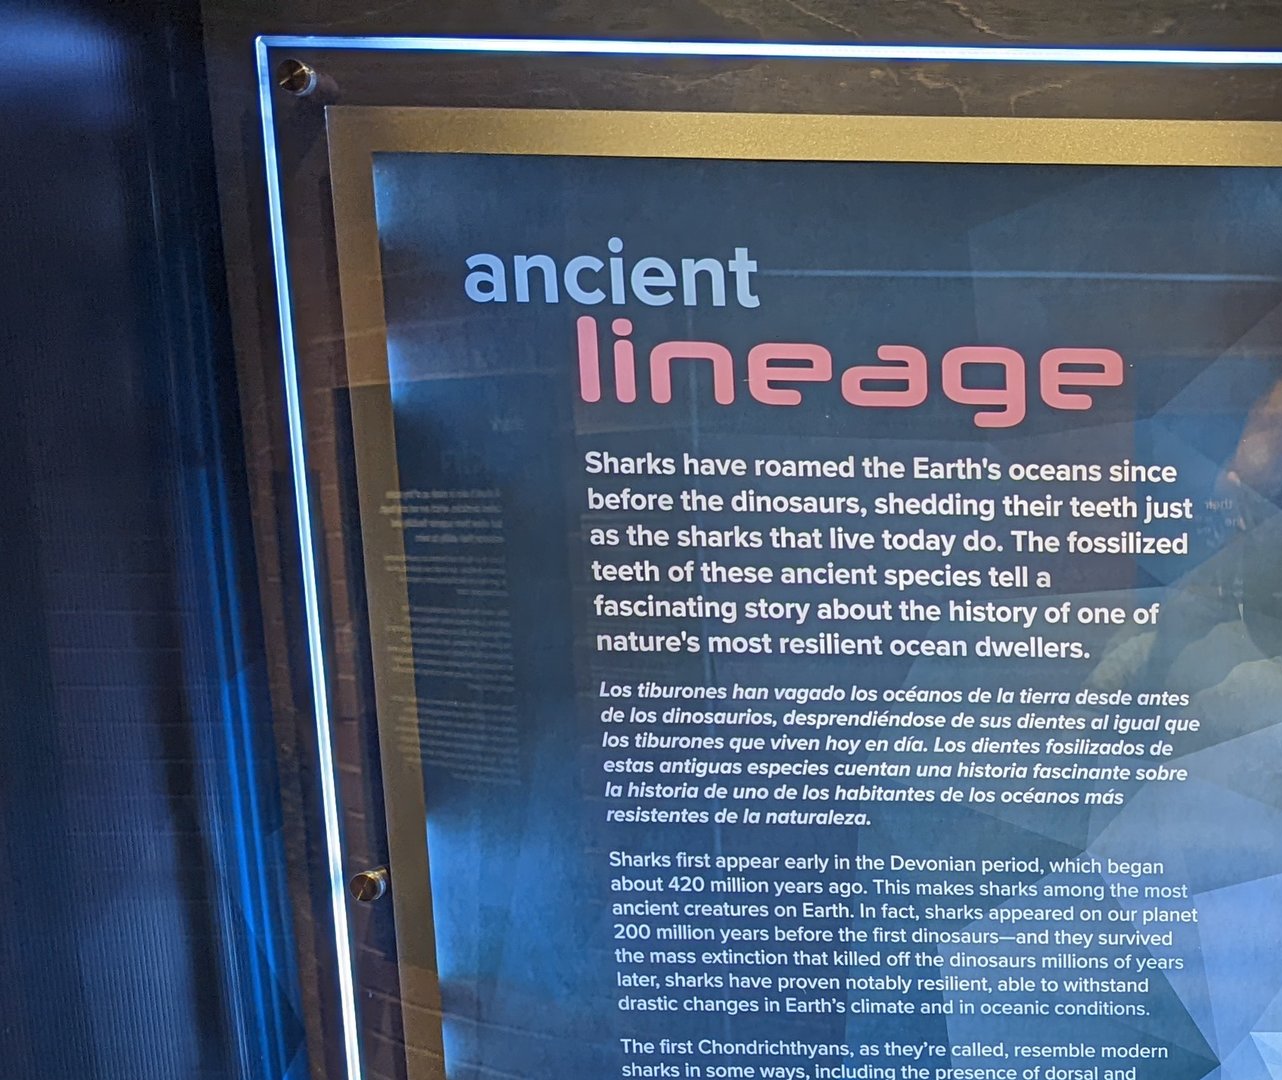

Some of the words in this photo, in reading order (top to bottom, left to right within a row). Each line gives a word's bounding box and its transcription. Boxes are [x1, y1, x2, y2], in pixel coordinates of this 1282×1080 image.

[464, 237, 760, 307] ancient
[576, 316, 1123, 427] lineage
[585, 450, 675, 475] Sharks
[683, 452, 747, 476] have
[754, 455, 854, 478] roamed
[861, 456, 905, 478] the
[913, 456, 1001, 480] Earth's
[1008, 463, 1102, 481] oceans
[1109, 459, 1177, 482] since
[587, 487, 673, 510] before
[680, 489, 724, 511] the
[730, 489, 867, 517] dinosaurs,
[874, 492, 994, 521] shedding
[1002, 494, 1063, 516] their
[1069, 495, 1137, 517] teeth
[1143, 495, 1193, 523] just
[590, 528, 619, 545] as
[625, 524, 669, 546] the
[677, 525, 762, 547] sharks
[769, 526, 823, 549] that
[829, 526, 875, 549] live
[881, 528, 956, 556] today
[963, 529, 1003, 551] do.
[1010, 530, 1060, 552] The
[1066, 530, 1187, 554] fossilized
[591, 560, 659, 581] teeth
[667, 560, 694, 582] of
[700, 560, 773, 583] these
[780, 561, 877, 585] ancient
[884, 563, 981, 590] species
[987, 565, 1028, 587] tell
[1036, 571, 1051, 587] a
[606, 806, 709, 823] resistentes
[714, 807, 738, 823] de
[742, 808, 760, 823] la
[765, 809, 871, 825] naturaleza.
[609, 851, 671, 867] Sharks
[675, 851, 711, 868] first
[715, 856, 779, 872] appear
[784, 853, 829, 873] early
[834, 854, 850, 869] in
[854, 854, 884, 870] the
[890, 855, 975, 871] Devonian
[981, 856, 1044, 875] period,
[1049, 857, 1101, 873] which
[1108, 858, 1163, 877] began
